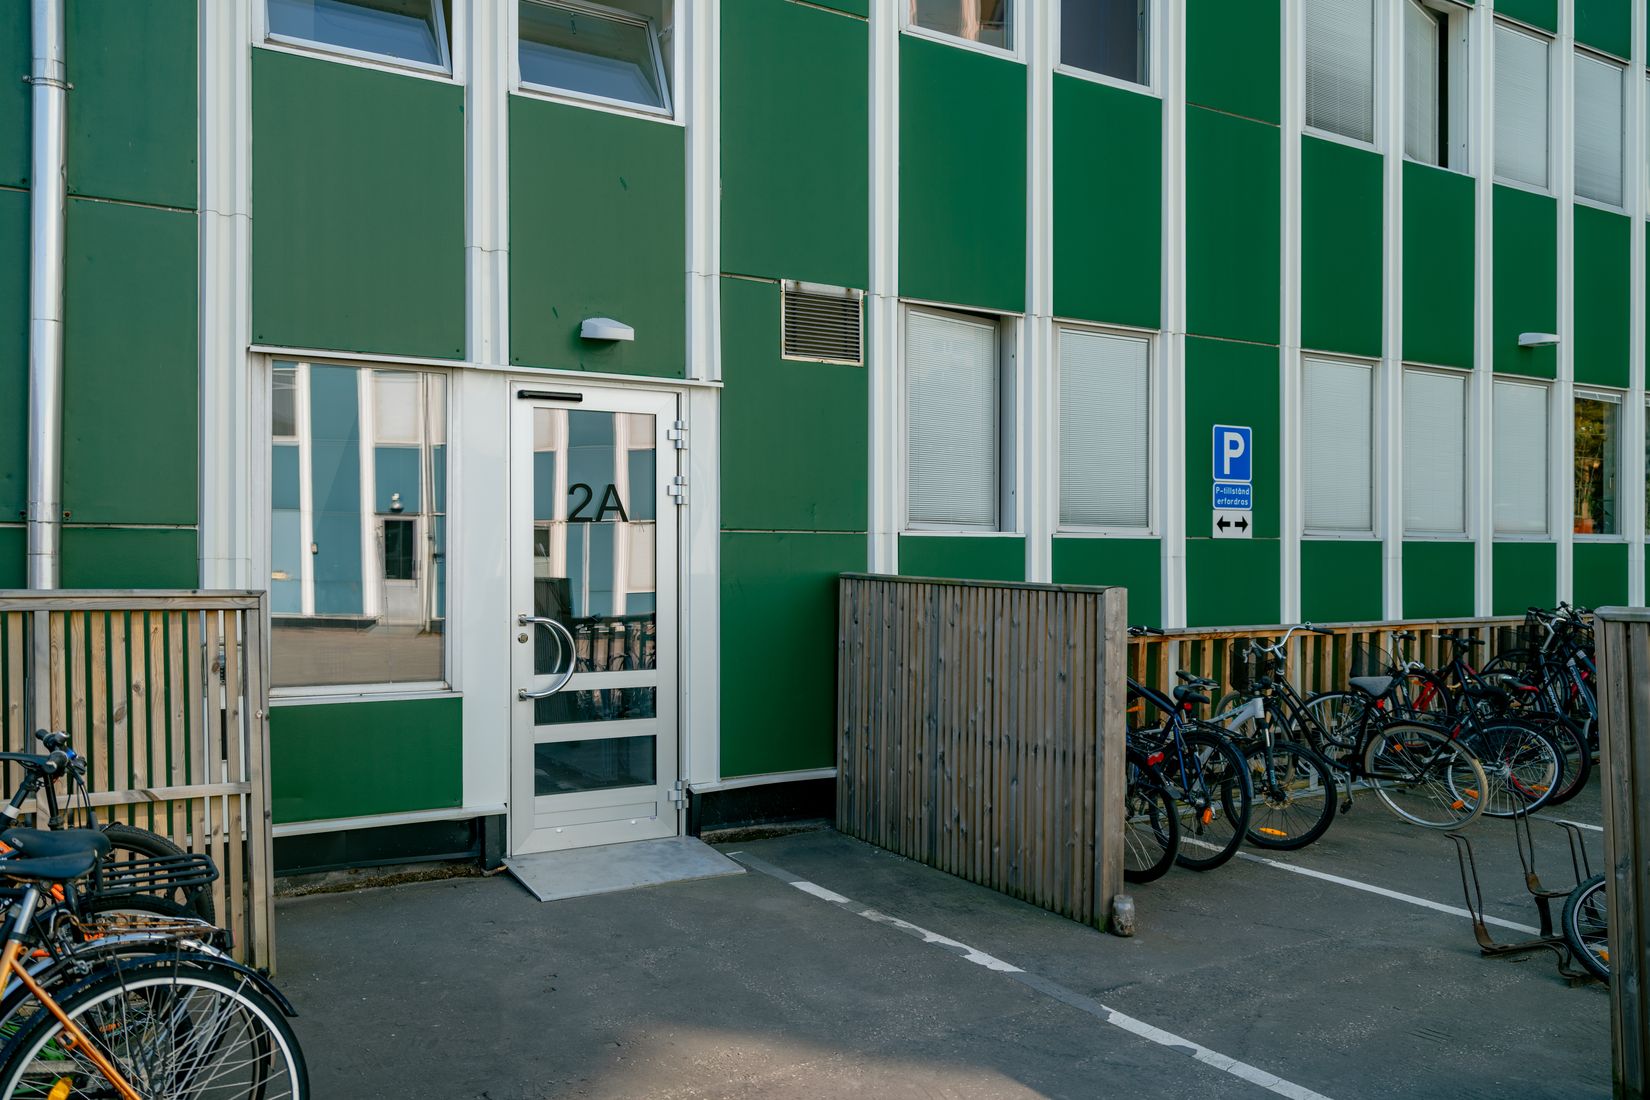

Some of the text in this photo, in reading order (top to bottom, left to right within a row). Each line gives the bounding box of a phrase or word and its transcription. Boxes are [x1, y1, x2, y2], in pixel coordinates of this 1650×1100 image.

[1224, 432, 1245, 474] P
[567, 483, 629, 522] 2A
[1216, 486, 1250, 495] P-tillstånd
